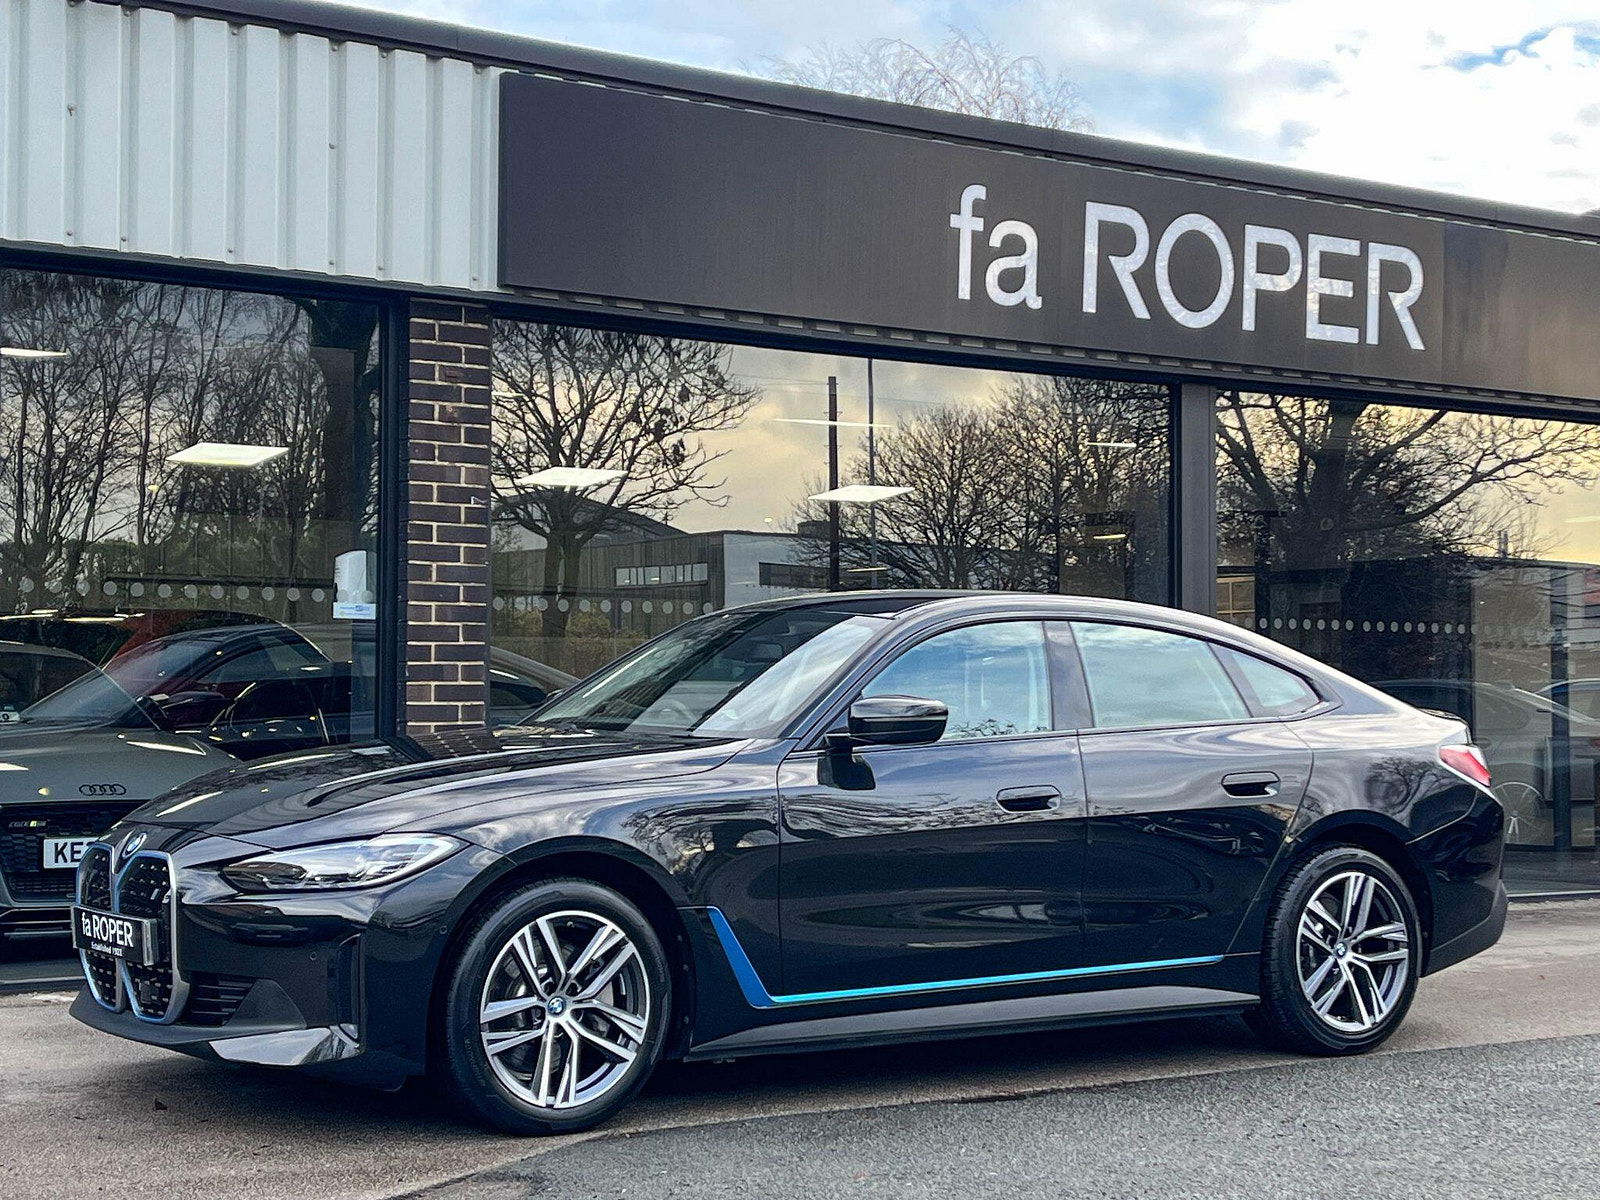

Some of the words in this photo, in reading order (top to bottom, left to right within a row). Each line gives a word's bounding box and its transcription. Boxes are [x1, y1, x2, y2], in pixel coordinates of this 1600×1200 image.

[949, 183, 1043, 310] fa
[1082, 201, 1426, 351] ROPER
[54, 841, 96, 864] KE
[81, 911, 92, 937] fa
[92, 914, 134, 948] ROPER
